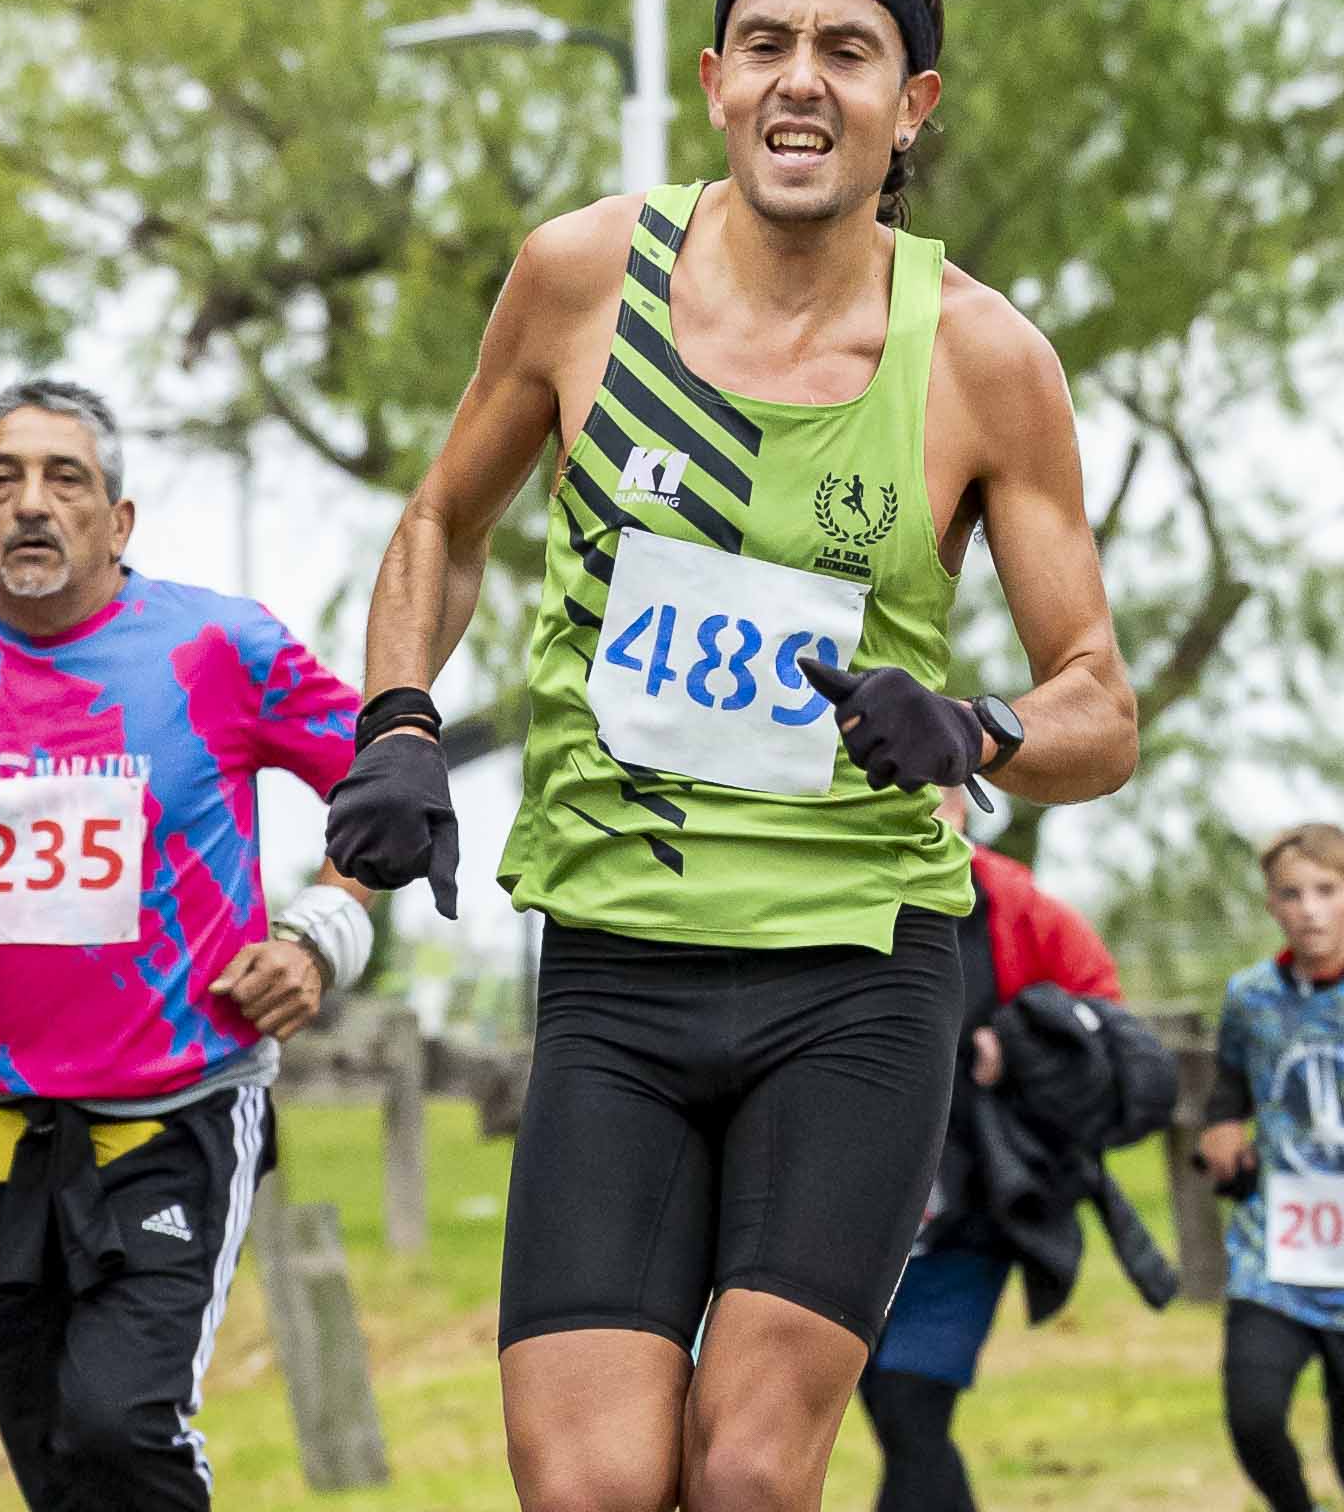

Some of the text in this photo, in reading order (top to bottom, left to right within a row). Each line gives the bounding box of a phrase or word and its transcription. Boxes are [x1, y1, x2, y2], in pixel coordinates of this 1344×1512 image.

[617, 446, 690, 495] K1
[822, 546, 841, 559] LA
[605, 604, 839, 726] 489
